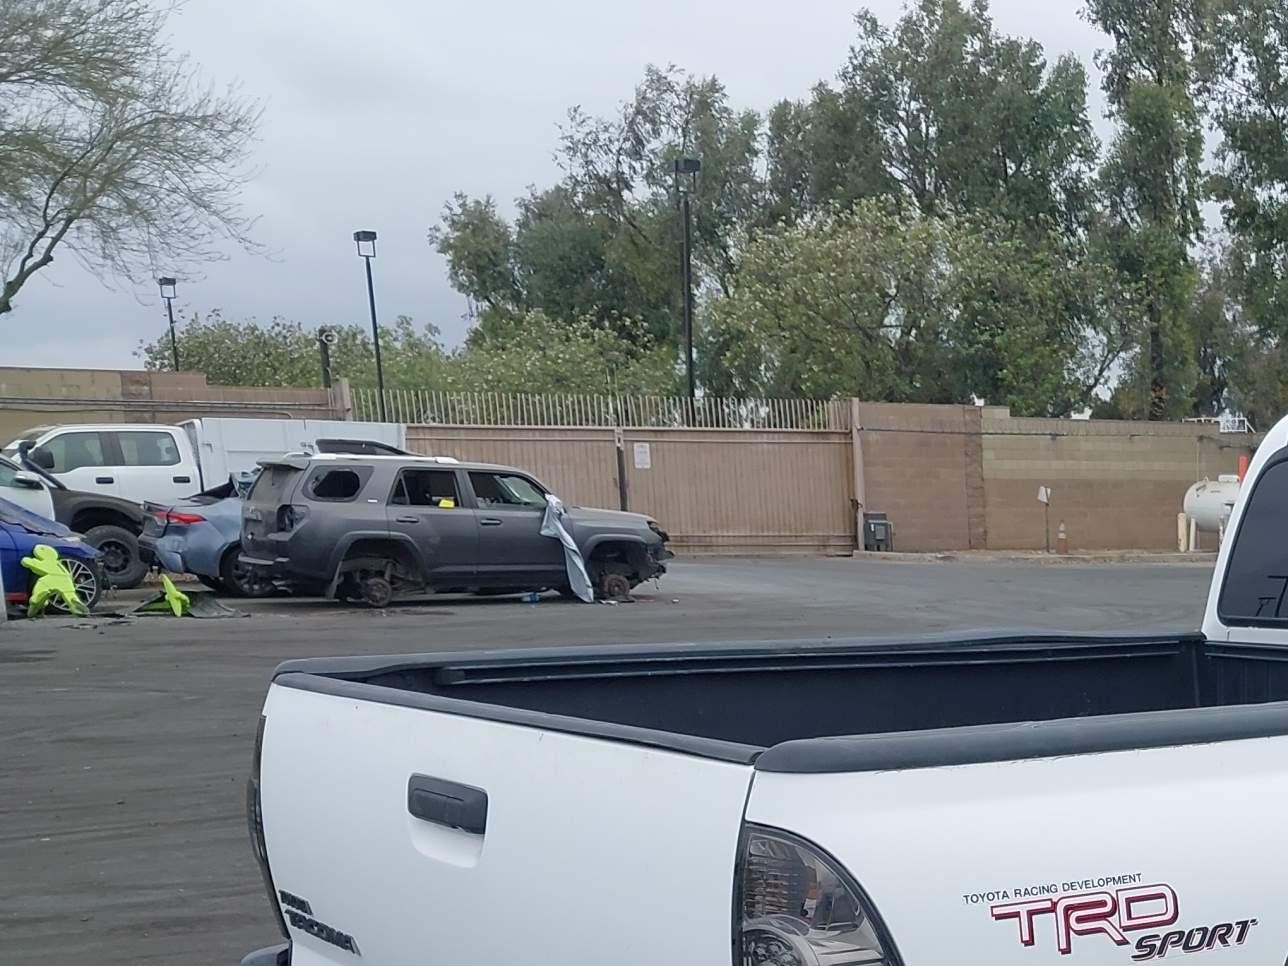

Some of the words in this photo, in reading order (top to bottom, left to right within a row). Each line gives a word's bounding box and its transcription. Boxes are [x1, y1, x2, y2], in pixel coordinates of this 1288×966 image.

[963, 889, 1009, 904] TOYOTA
[1014, 884, 1058, 899] RACING
[1062, 873, 1142, 892] DEVELOPMENT
[990, 883, 1179, 955] TRD
[1131, 919, 1258, 961] SPORT
